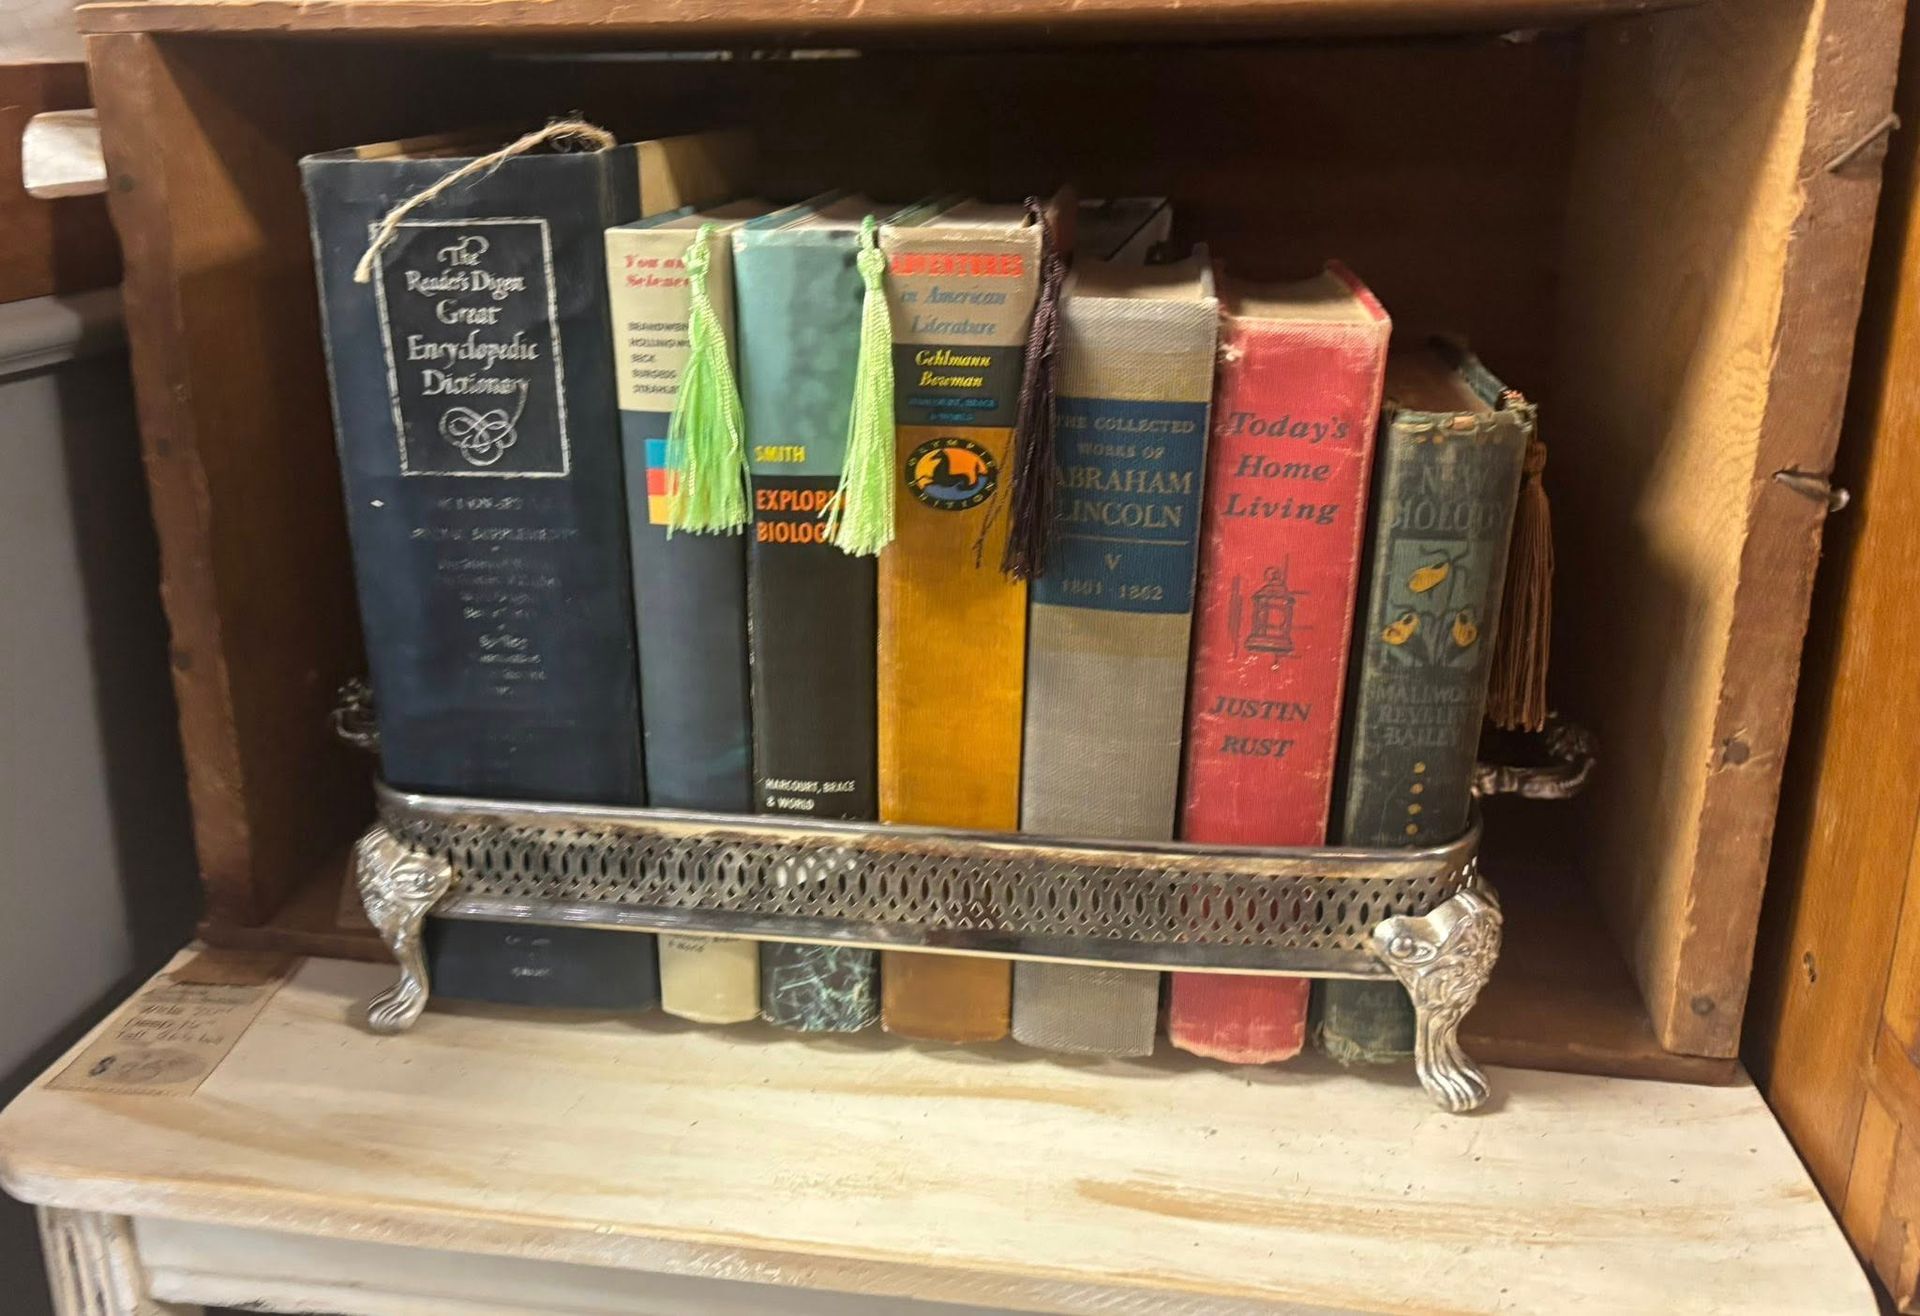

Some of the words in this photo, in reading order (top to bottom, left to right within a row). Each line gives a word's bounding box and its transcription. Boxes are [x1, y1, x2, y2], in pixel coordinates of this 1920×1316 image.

[437, 236, 490, 267] The
[663, 258, 687, 269] an
[890, 254, 1024, 277] ADVENTURES
[924, 286, 1008, 305] American
[435, 299, 503, 325] Great
[911, 315, 997, 335] Literature
[407, 329, 541, 371] Encyclopedic
[915, 349, 992, 368] Gehlmann
[422, 369, 532, 403] Dictionary
[918, 371, 985, 388] Bowman
[1093, 416, 1197, 433] COLLECTED
[1229, 411, 1351, 444] Today's
[754, 445, 807, 463] SMITH
[1077, 442, 1136, 458] WORKS
[1141, 446, 1165, 460] OF
[1234, 452, 1330, 482] Home
[1222, 492, 1340, 525] Living
[756, 521, 832, 544] BIOLOG
[1104, 553, 1122, 571] V
[1209, 696, 1313, 722] JUSTIN
[1221, 735, 1295, 759] RUST
[765, 778, 821, 794] HARCOURT,
[822, 780, 856, 794] BRACE
[766, 796, 776, 808] &
[778, 797, 816, 811] WORLD
